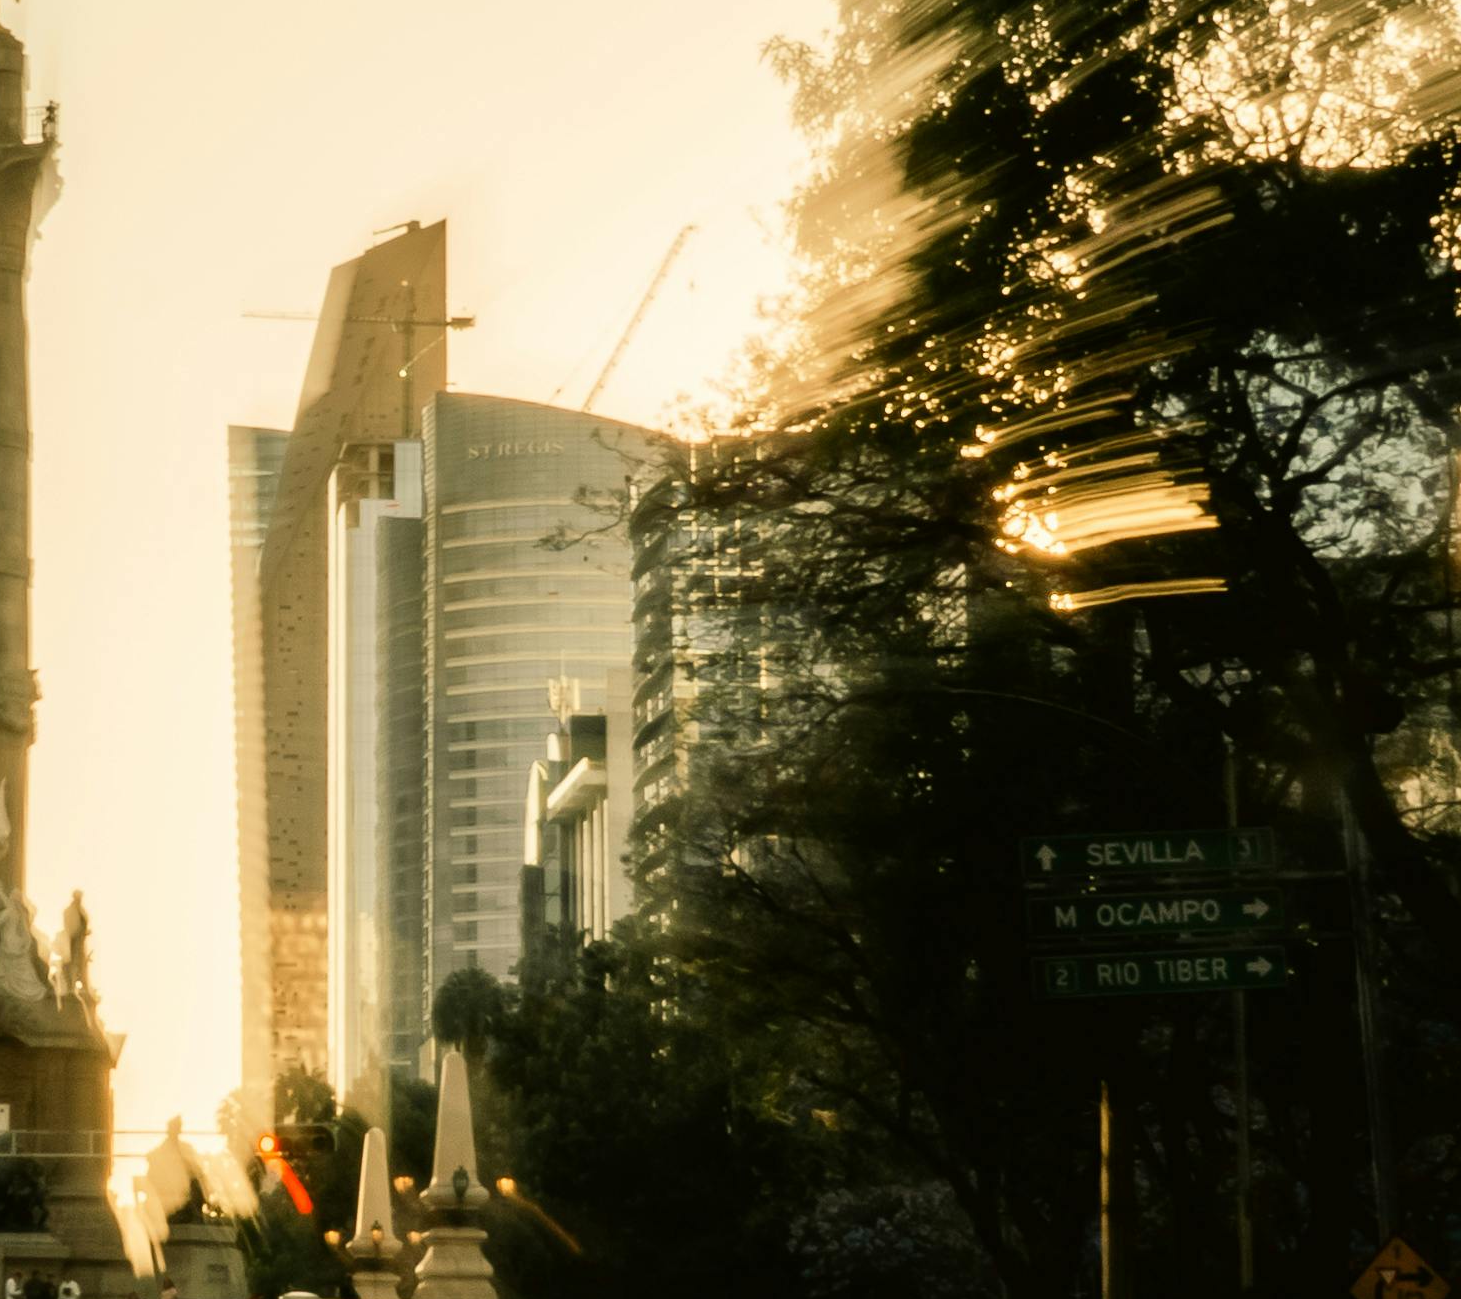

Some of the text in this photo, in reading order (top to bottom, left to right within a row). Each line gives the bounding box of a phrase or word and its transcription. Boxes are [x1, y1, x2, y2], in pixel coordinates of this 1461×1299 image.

[498, 439, 565, 457] REGIS
[1086, 839, 1206, 867] SEVILLA
[1054, 899, 1221, 928] M OCAMPO
[1055, 956, 1229, 987] 2 RIO TIBER
